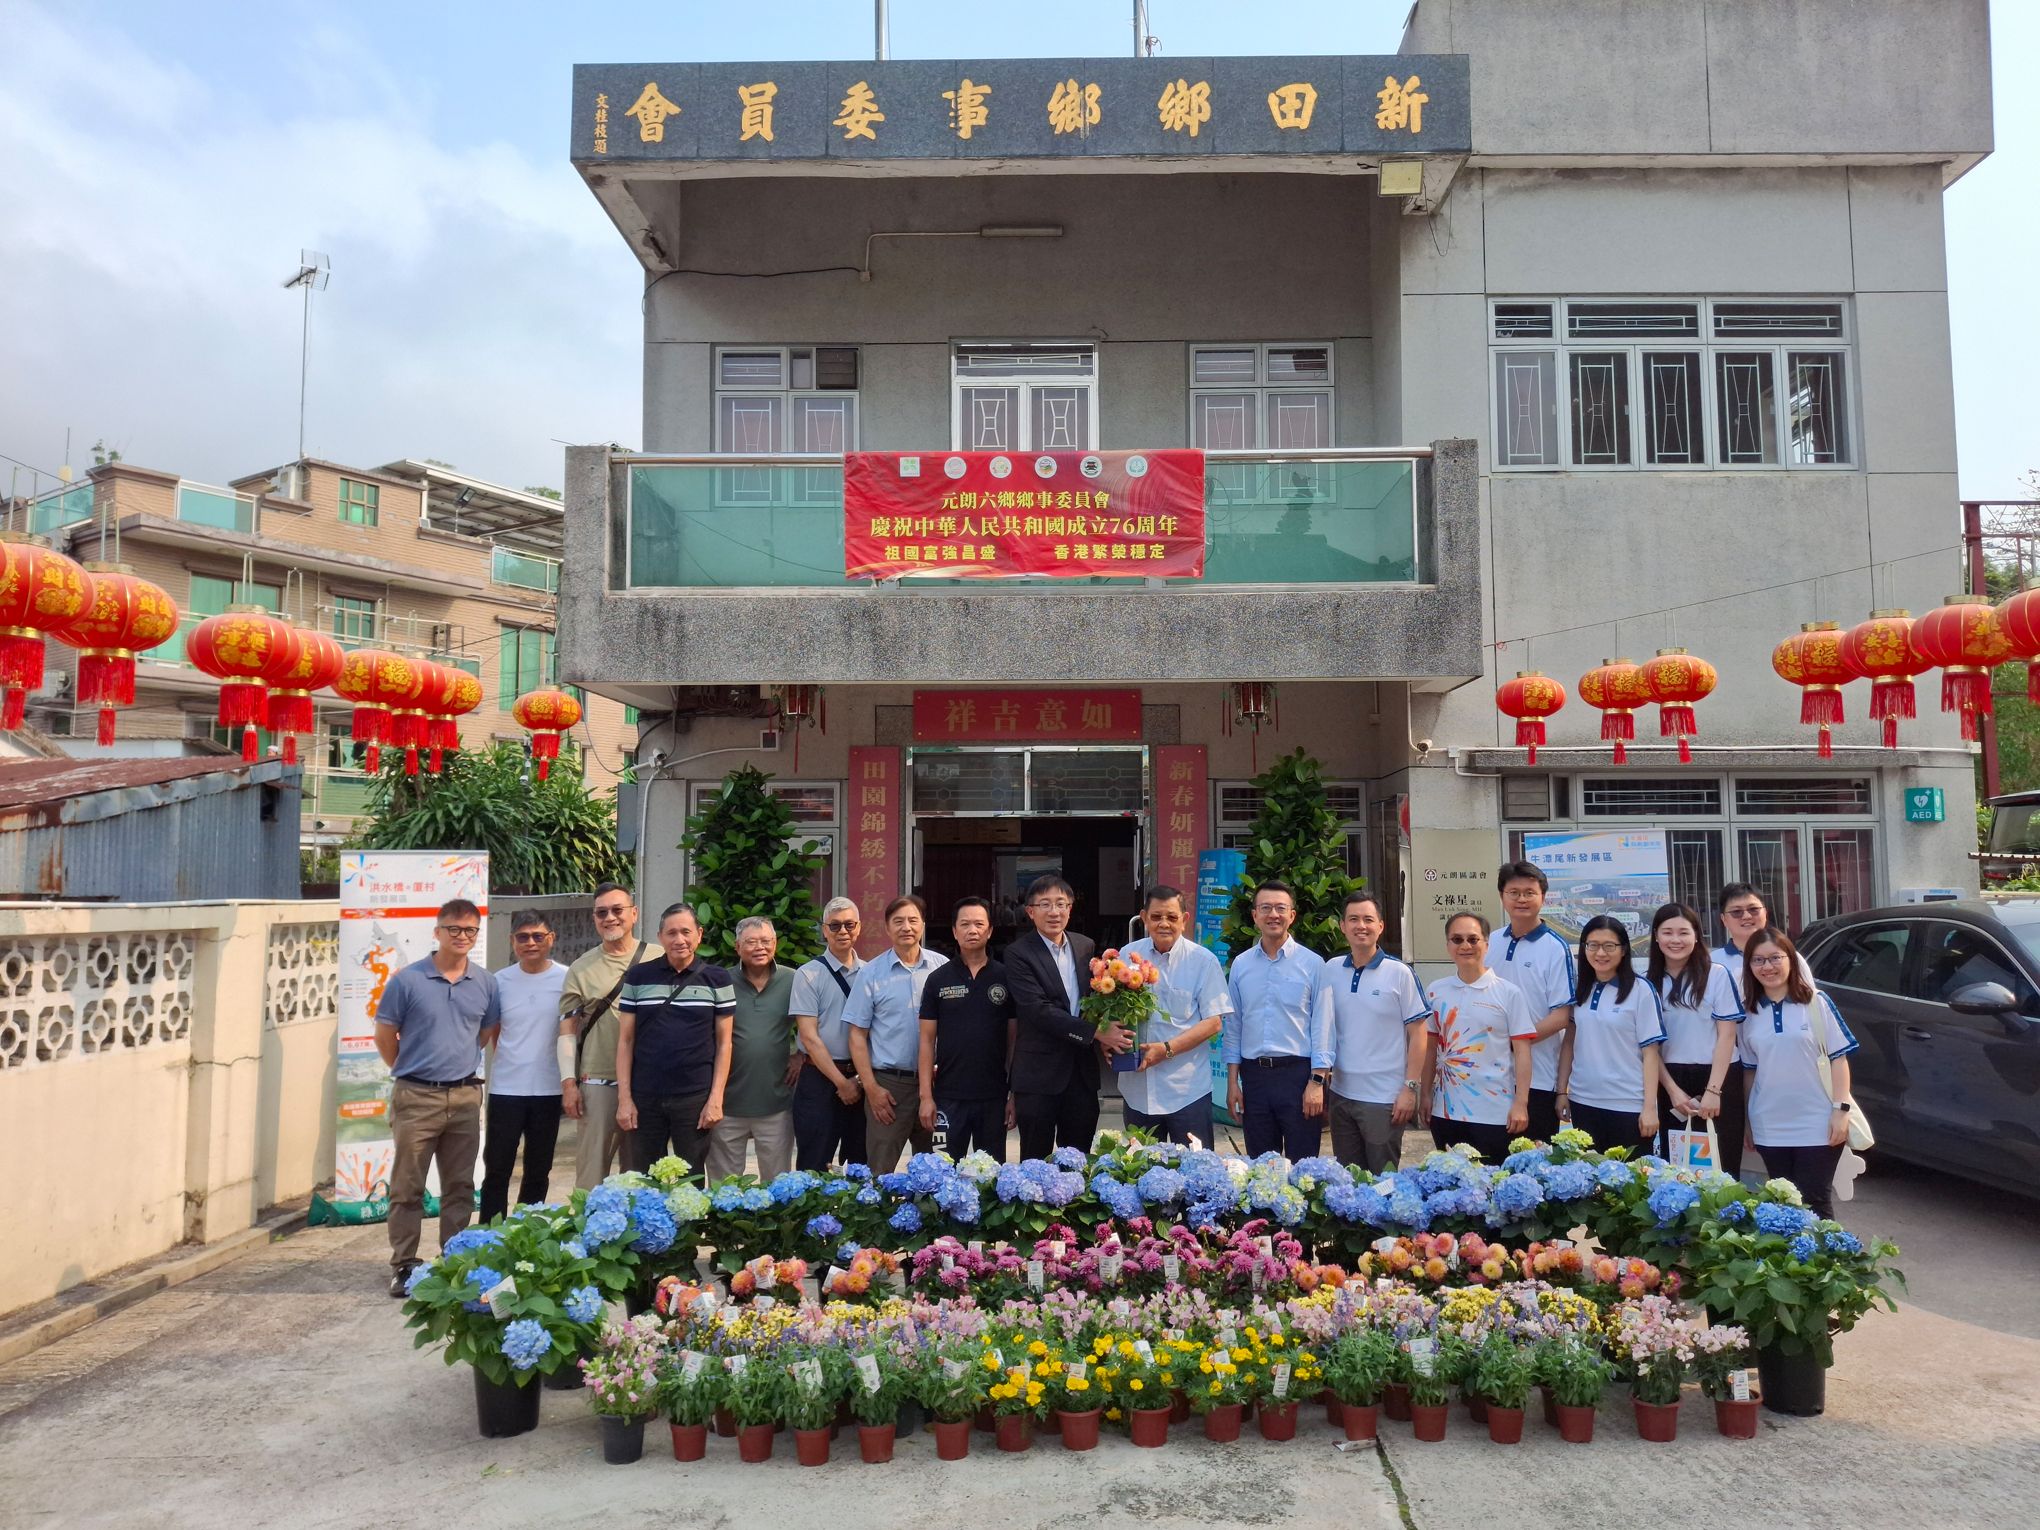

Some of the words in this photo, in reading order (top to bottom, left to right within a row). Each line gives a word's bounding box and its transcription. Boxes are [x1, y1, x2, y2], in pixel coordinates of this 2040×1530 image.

[625, 75, 1429, 143] 新田鄉鄉事委員會
[941, 491, 1111, 510] 元朗六鄉鄉事委員會
[870, 515, 1179, 538] 慶祝中華人民共和國成立76周年
[885, 545, 996, 561] 祖國富強昌盛
[1054, 543, 1165, 560] 香港繁榮穩定
[944, 698, 1113, 733] 如意吉祥
[1912, 811, 1932, 819] AED
[1531, 852, 1613, 863] 牛潭尾新發展區
